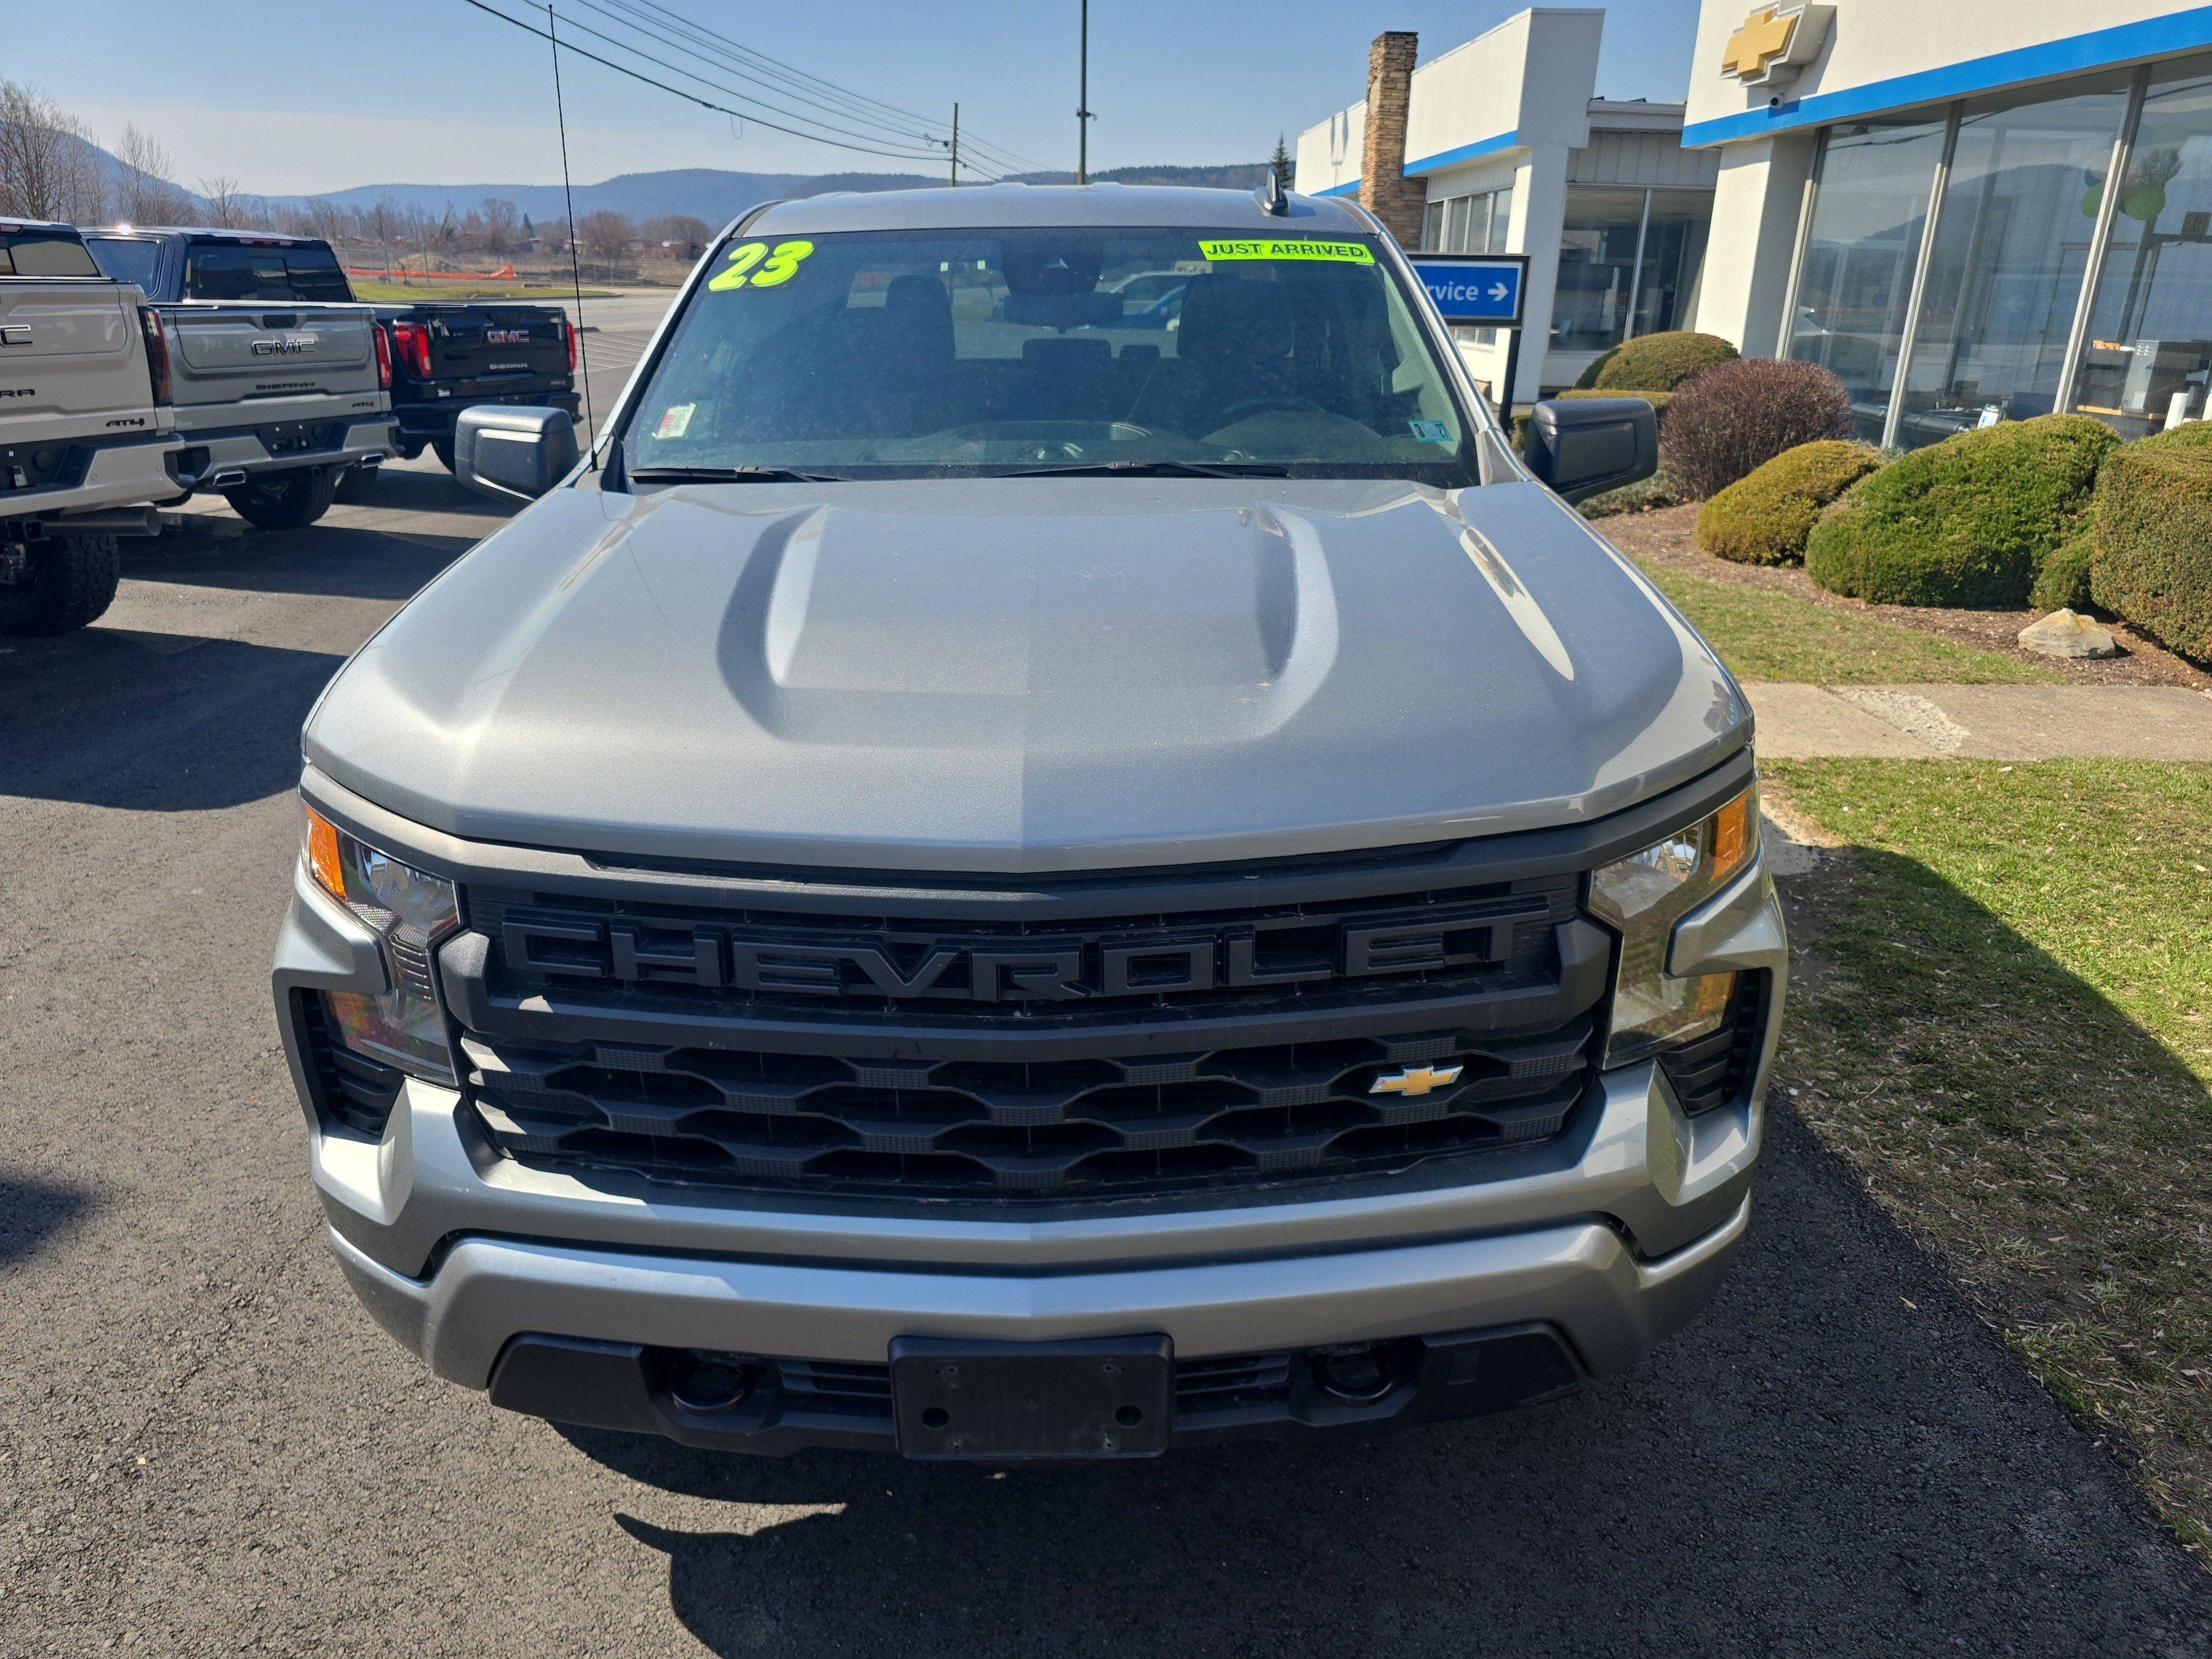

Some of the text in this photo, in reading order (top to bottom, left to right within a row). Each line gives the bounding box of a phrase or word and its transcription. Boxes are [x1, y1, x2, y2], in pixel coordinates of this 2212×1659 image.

[1207, 243, 1367, 259] JUST ARRIVED
[709, 240, 814, 292] 23
[487, 329, 530, 343] GMC
[252, 338, 315, 357] GMC
[106, 418, 145, 428] AT4
[501, 896, 1549, 1002] CHEVROLET
